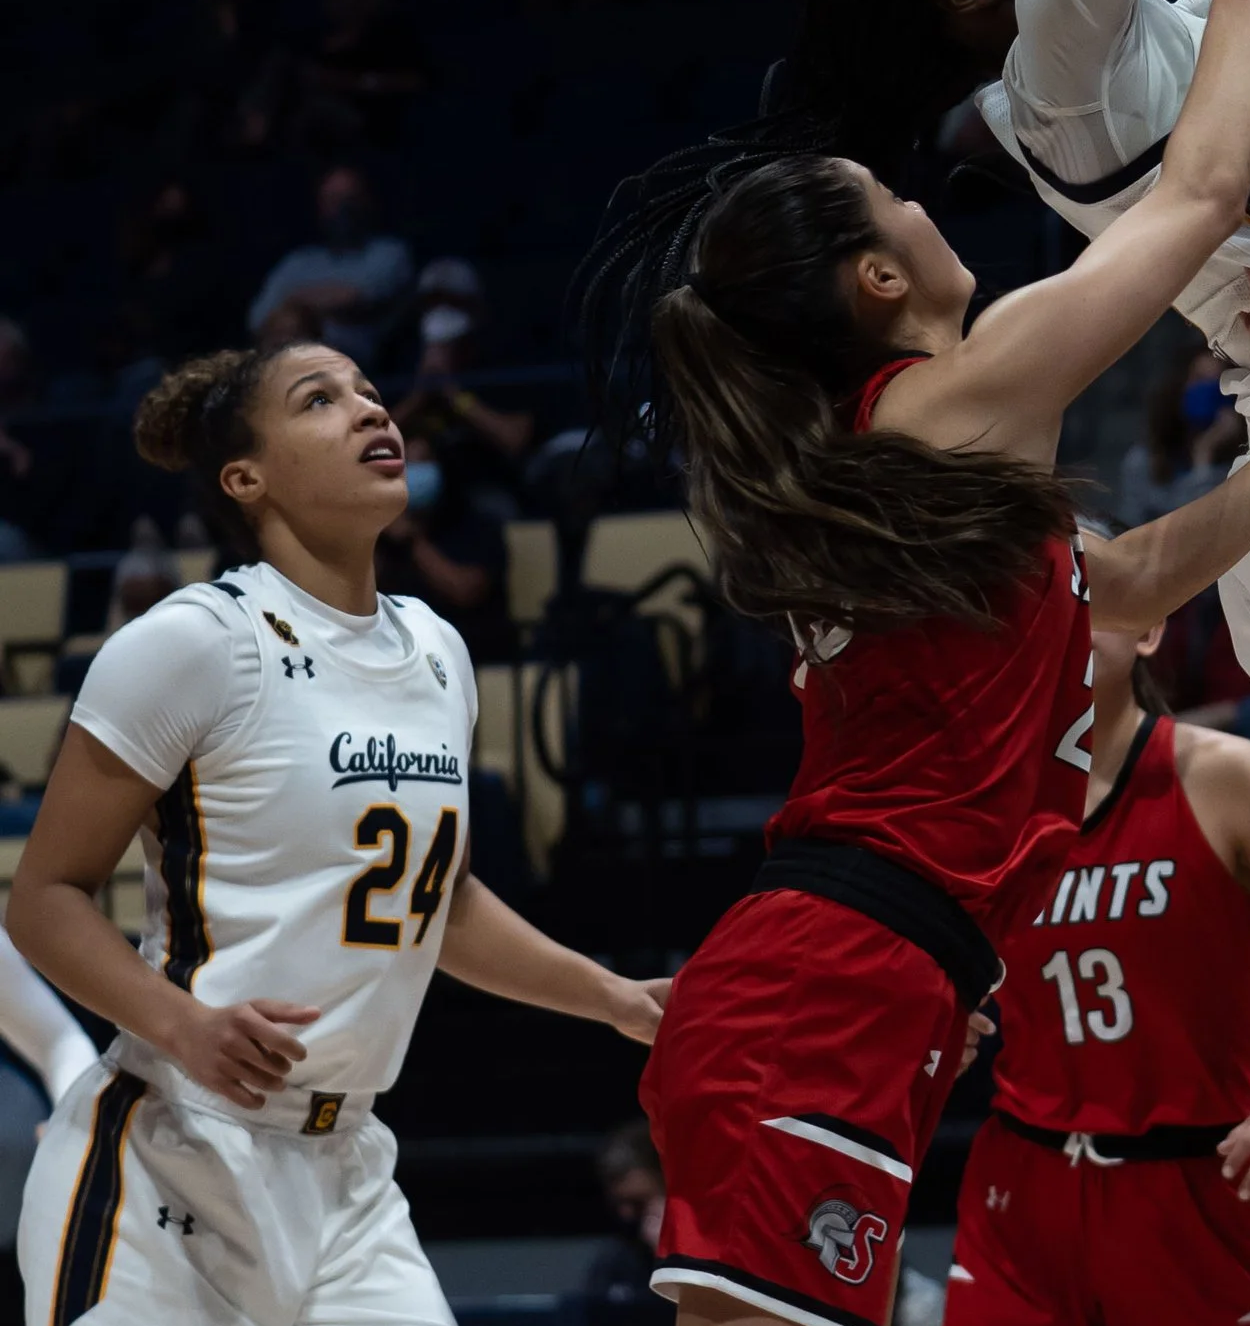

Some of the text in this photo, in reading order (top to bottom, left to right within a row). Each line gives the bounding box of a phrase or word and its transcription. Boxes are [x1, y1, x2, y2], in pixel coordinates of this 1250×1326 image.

[329, 731, 462, 791] California
[341, 803, 459, 949] 24
[1031, 858, 1176, 926] INTS
[1040, 946, 1134, 1046] 13
